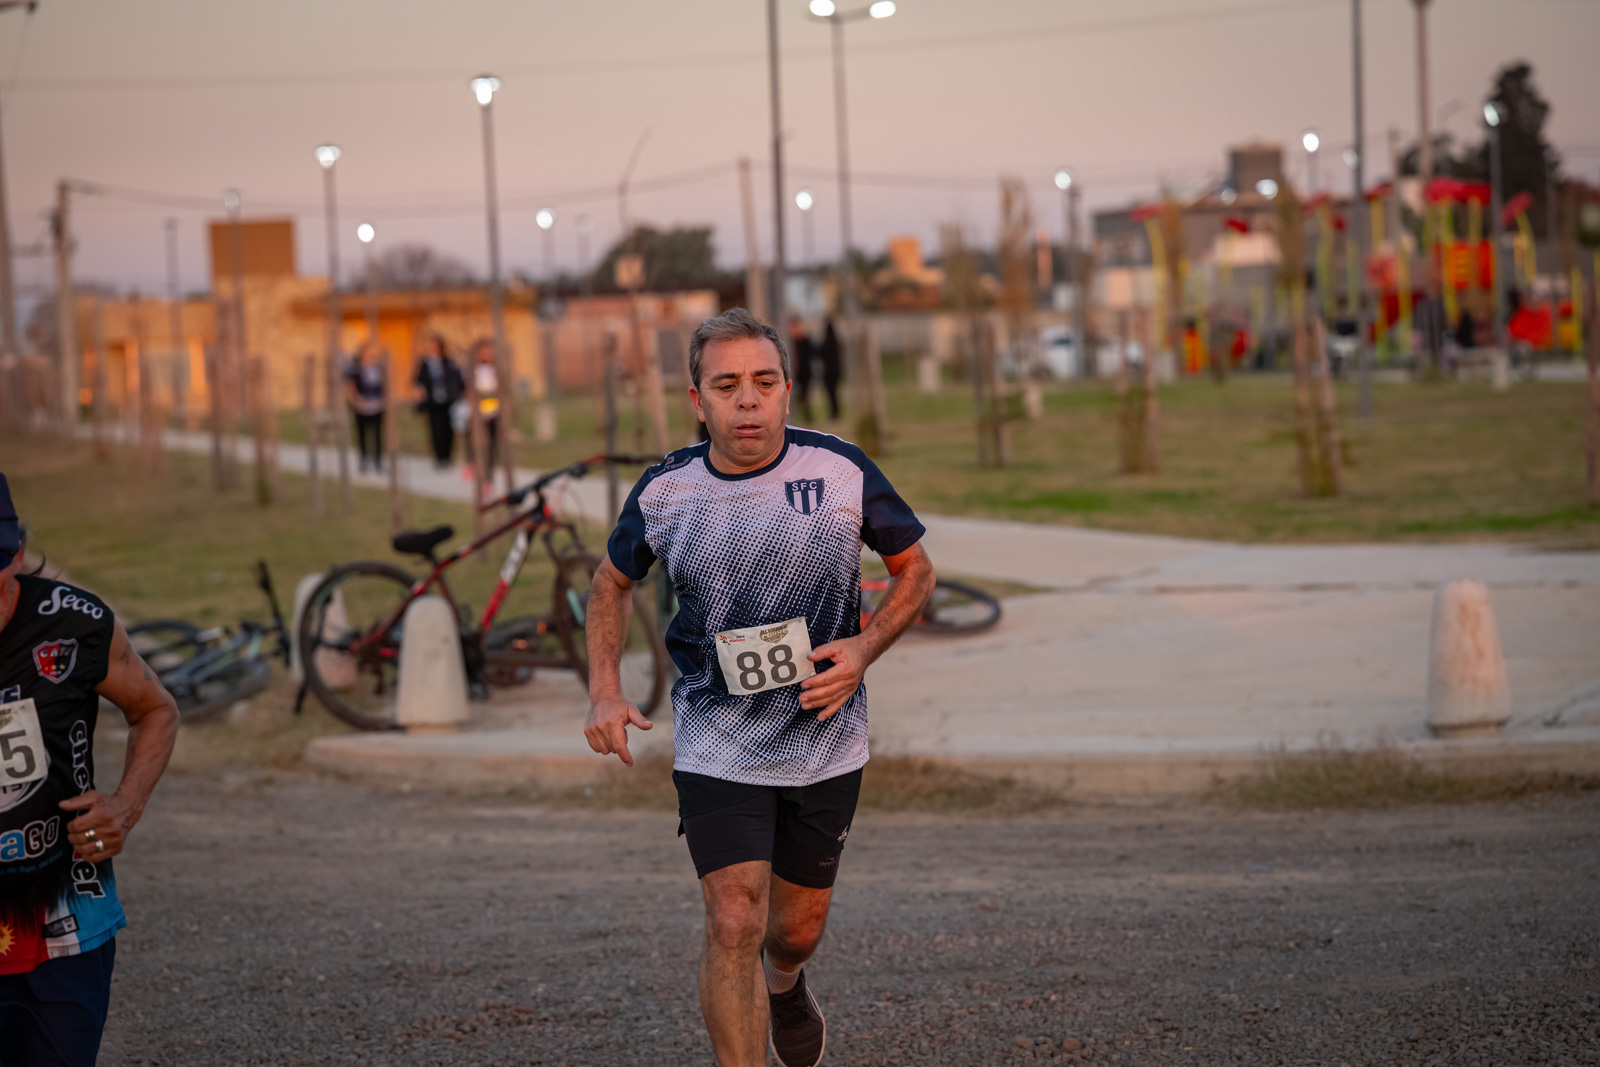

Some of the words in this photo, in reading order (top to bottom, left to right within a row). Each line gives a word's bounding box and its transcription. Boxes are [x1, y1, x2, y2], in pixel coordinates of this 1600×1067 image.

[791, 481, 818, 491] SFC
[38, 585, 104, 619] Secco
[736, 644, 798, 691] 88
[0, 729, 36, 779] 5
